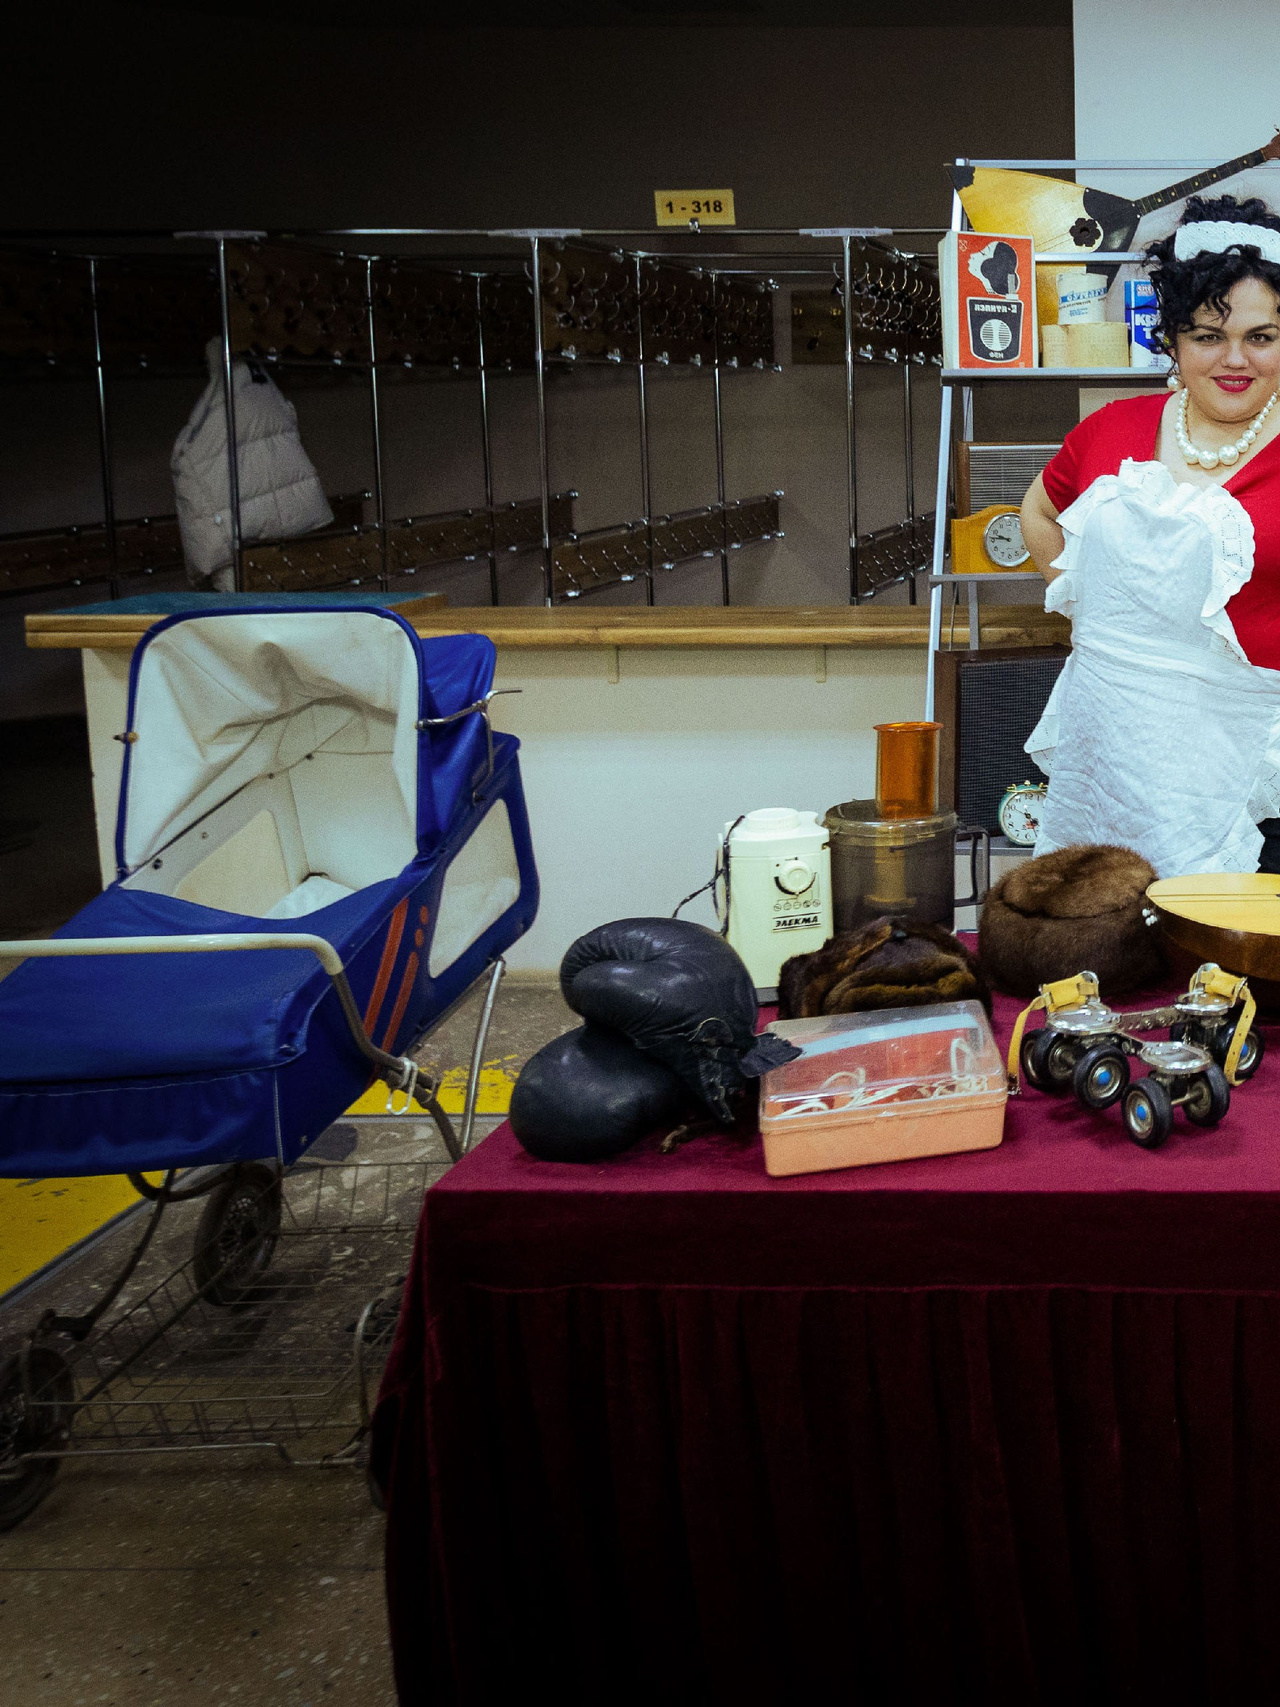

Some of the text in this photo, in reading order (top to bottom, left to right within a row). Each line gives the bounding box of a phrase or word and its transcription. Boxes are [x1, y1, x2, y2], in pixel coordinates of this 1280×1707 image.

[665, 200, 674, 213] 1
[691, 200, 723, 213] 318
[775, 915, 819, 928] ЭЛЕКМА
